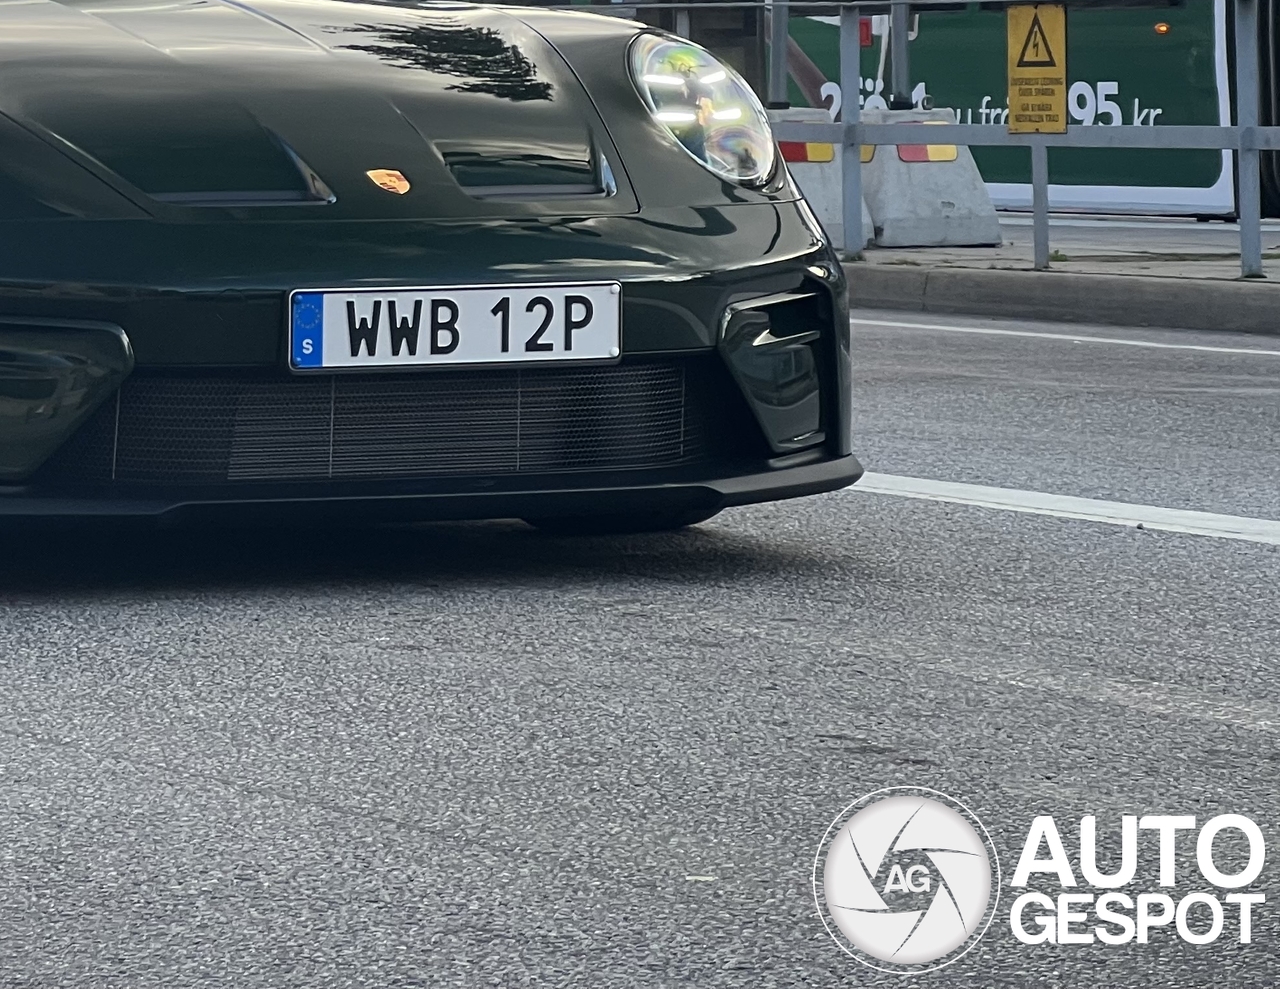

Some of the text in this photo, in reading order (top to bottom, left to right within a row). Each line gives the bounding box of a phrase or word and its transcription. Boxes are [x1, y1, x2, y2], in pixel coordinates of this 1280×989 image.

[1068, 80, 1123, 126] 95
[302, 339, 313, 355] S
[346, 295, 595, 358] WWB 12P
